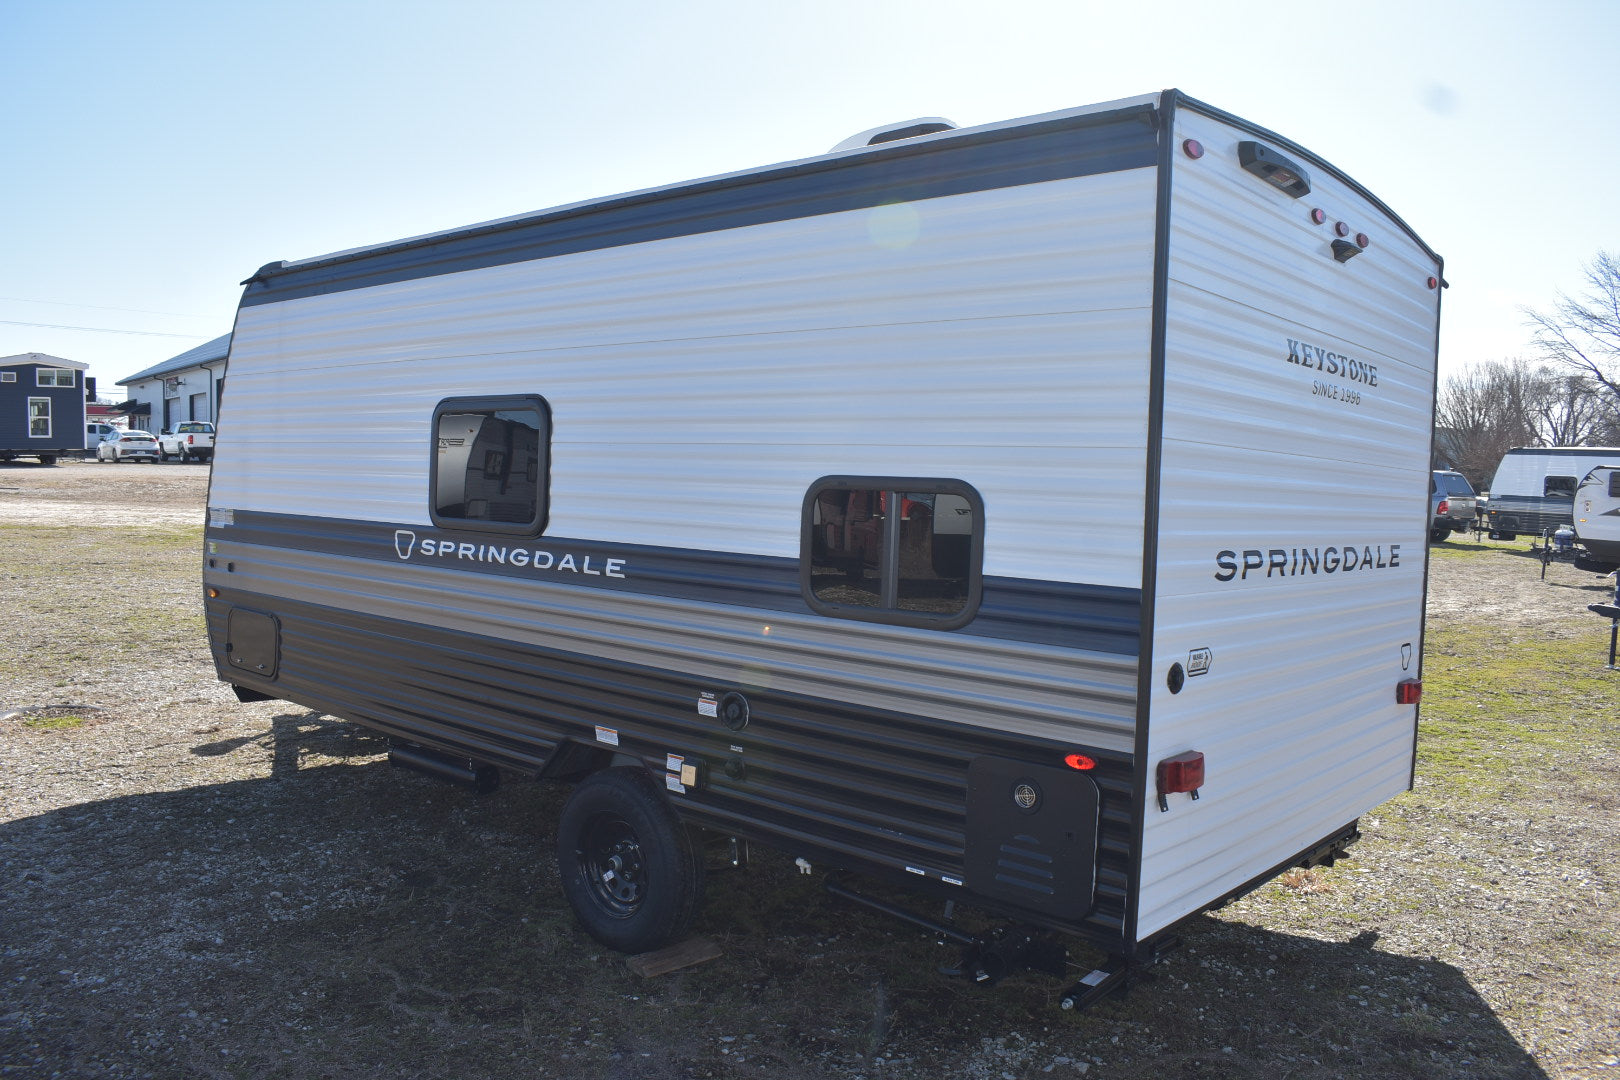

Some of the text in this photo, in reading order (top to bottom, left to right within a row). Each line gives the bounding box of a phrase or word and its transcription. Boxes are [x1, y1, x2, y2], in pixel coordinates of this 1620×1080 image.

[1287, 338, 1377, 387] KEYSTONE
[1312, 380, 1361, 405] SINCE 1996
[420, 539, 626, 579] SPRINGDALE
[1214, 544, 1400, 581] SPRINGDALE
